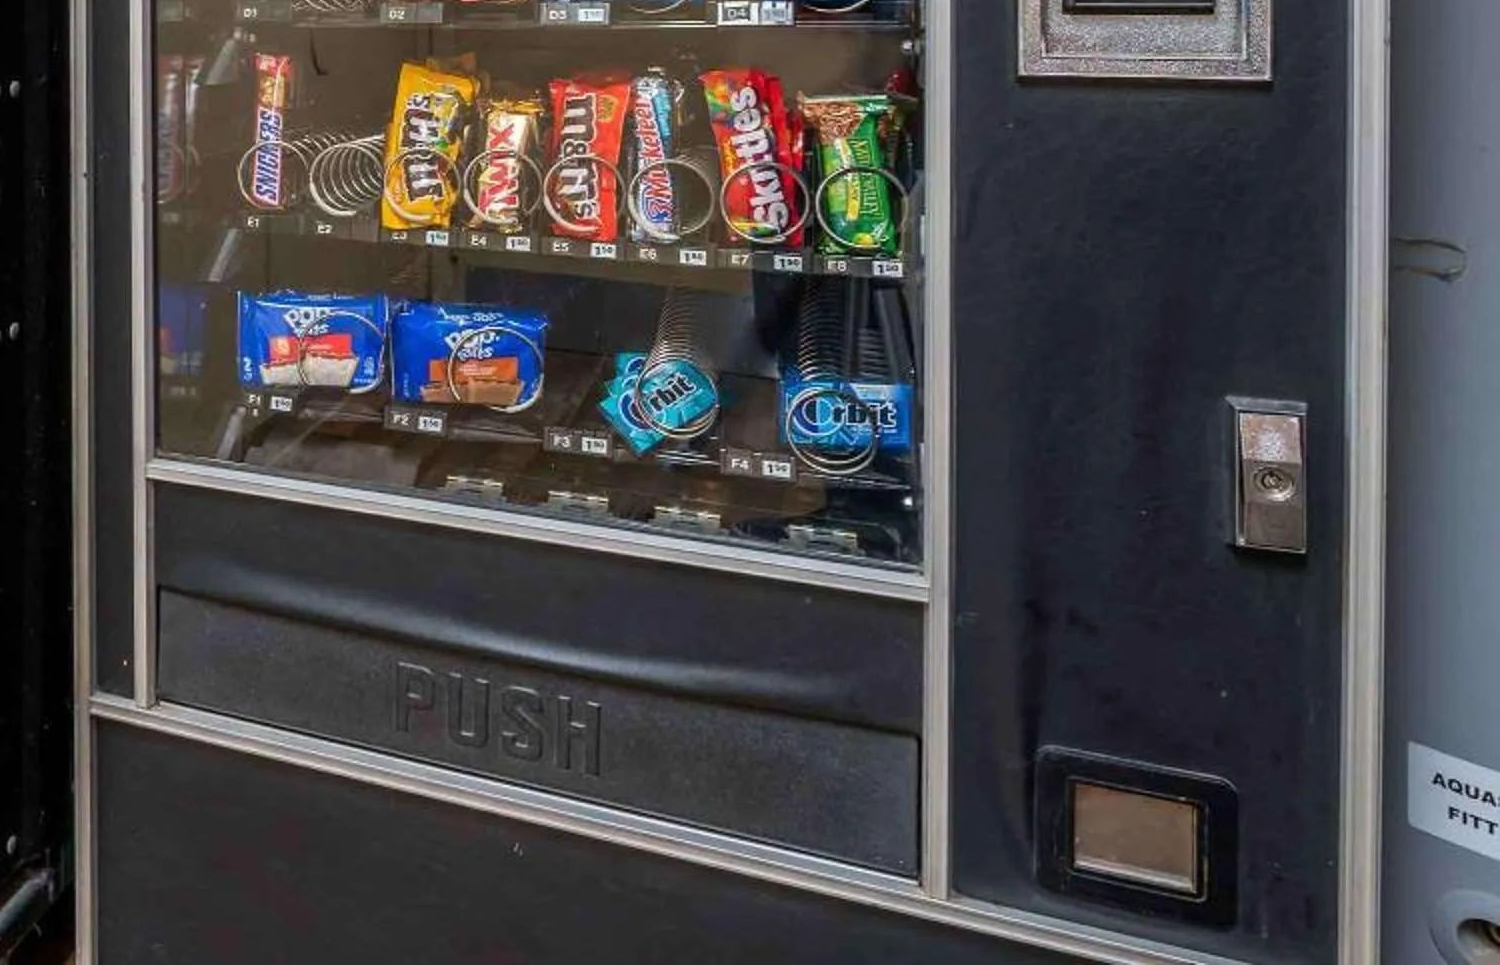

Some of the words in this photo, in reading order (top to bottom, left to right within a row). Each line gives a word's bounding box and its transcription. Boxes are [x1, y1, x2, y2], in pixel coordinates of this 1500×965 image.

[254, 108, 282, 204] SNICKERS
[553, 435, 571, 448] F3
[731, 458, 749, 470] F4
[394, 662, 602, 778] PUSH
